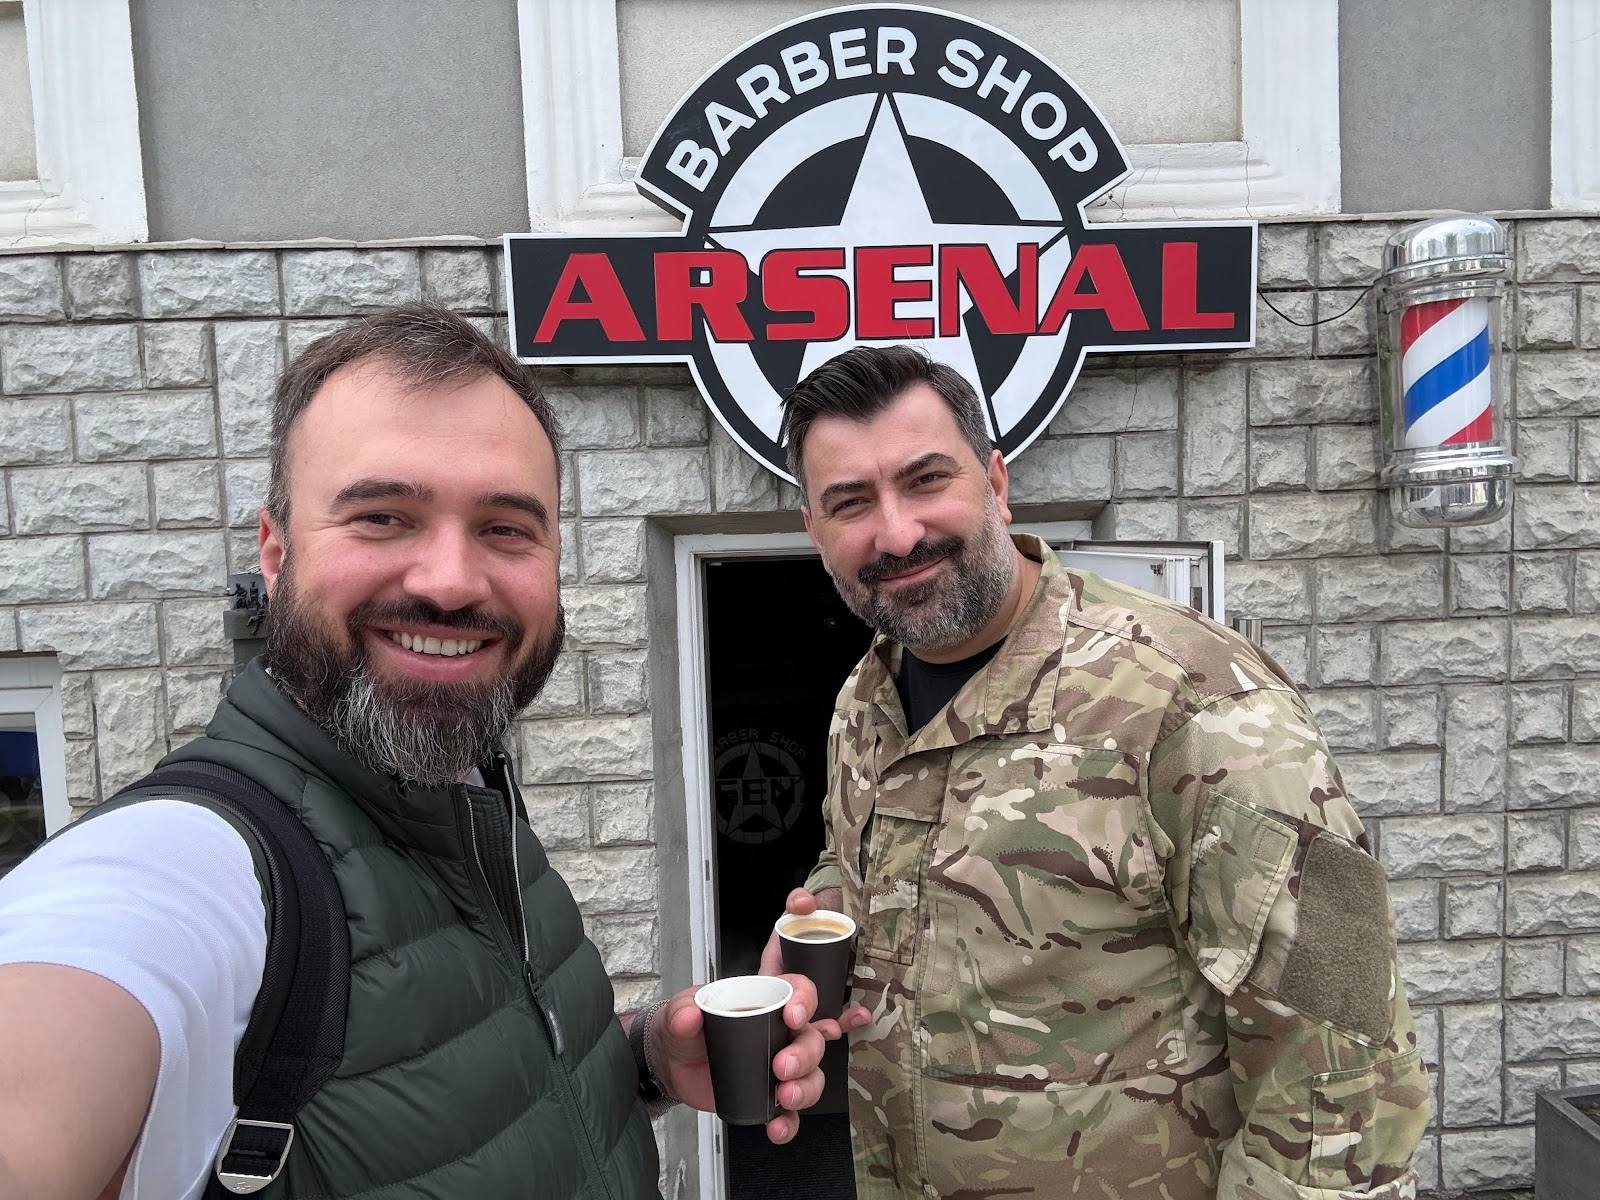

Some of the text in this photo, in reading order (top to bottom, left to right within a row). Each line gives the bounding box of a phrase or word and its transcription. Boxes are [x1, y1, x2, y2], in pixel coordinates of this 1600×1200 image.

[666, 26, 1099, 192] BARBER SHOP
[532, 241, 1236, 344] ARSENAL
[714, 728, 759, 755] ARBER
